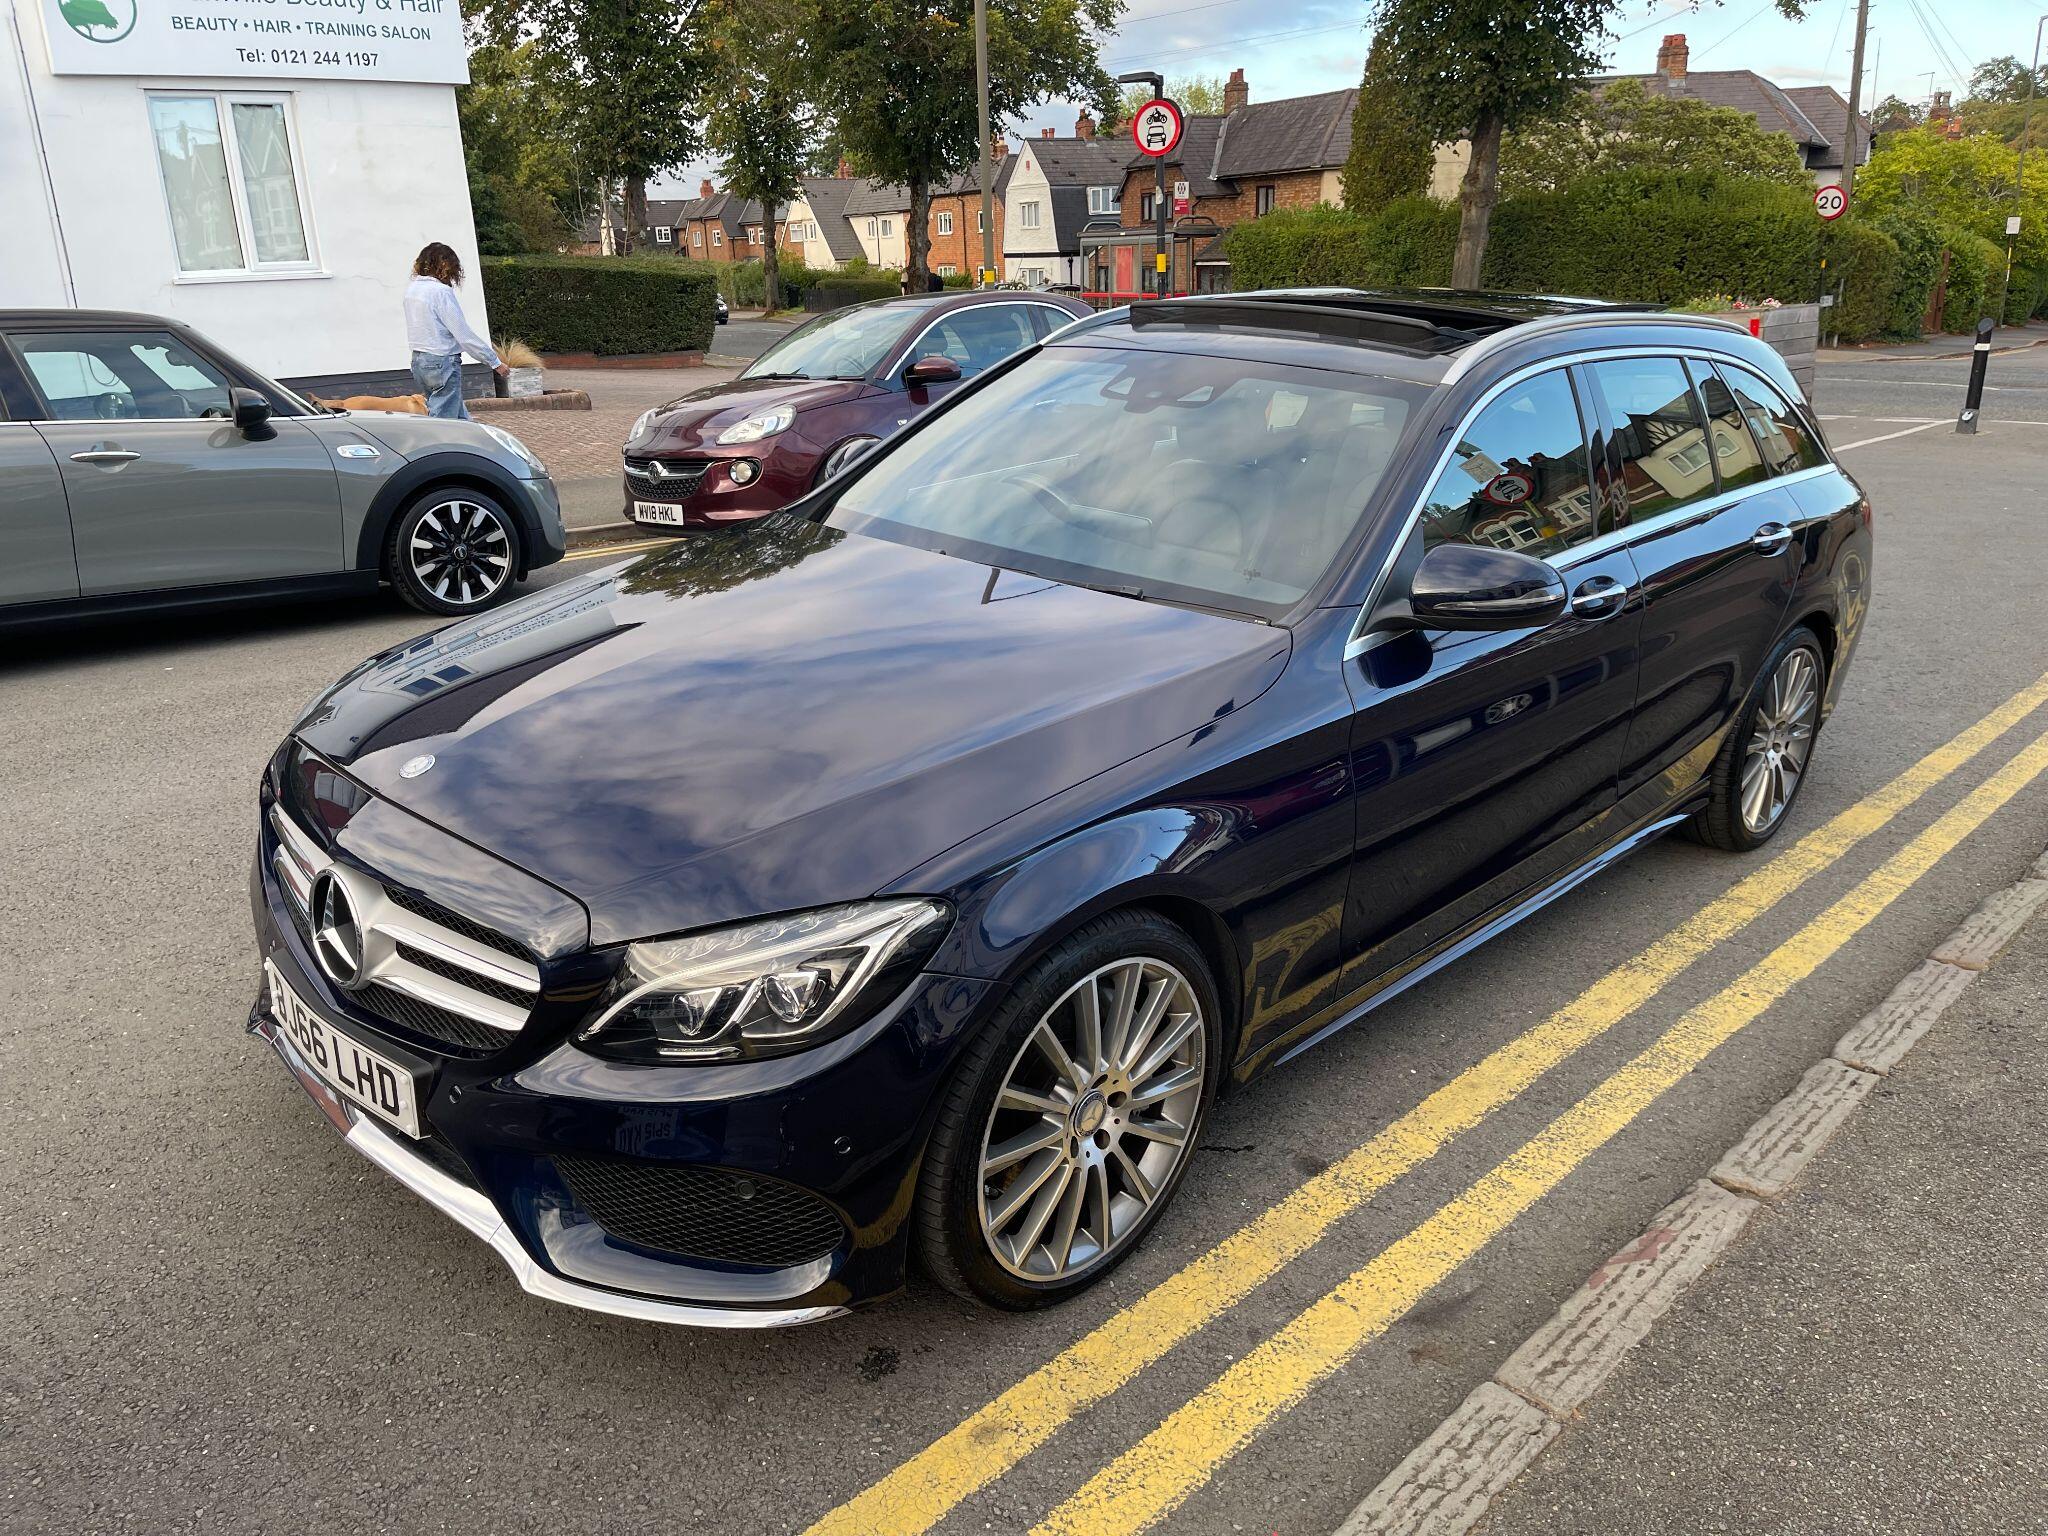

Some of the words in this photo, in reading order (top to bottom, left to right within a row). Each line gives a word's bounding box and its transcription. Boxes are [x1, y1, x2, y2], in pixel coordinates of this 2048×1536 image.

[171, 16, 238, 31] BEAUTY
[253, 19, 292, 33] HAIR
[305, 21, 377, 37] TRAINING
[381, 25, 431, 40] SALON
[236, 47, 266, 62] Tel:
[271, 49, 307, 64] 0121
[313, 50, 341, 65] 244
[345, 52, 378, 66] 1197
[1818, 195, 1842, 210] 20
[657, 505, 677, 522] HKL
[274, 973, 328, 1069] BJ66
[332, 1034, 400, 1117] LHD
